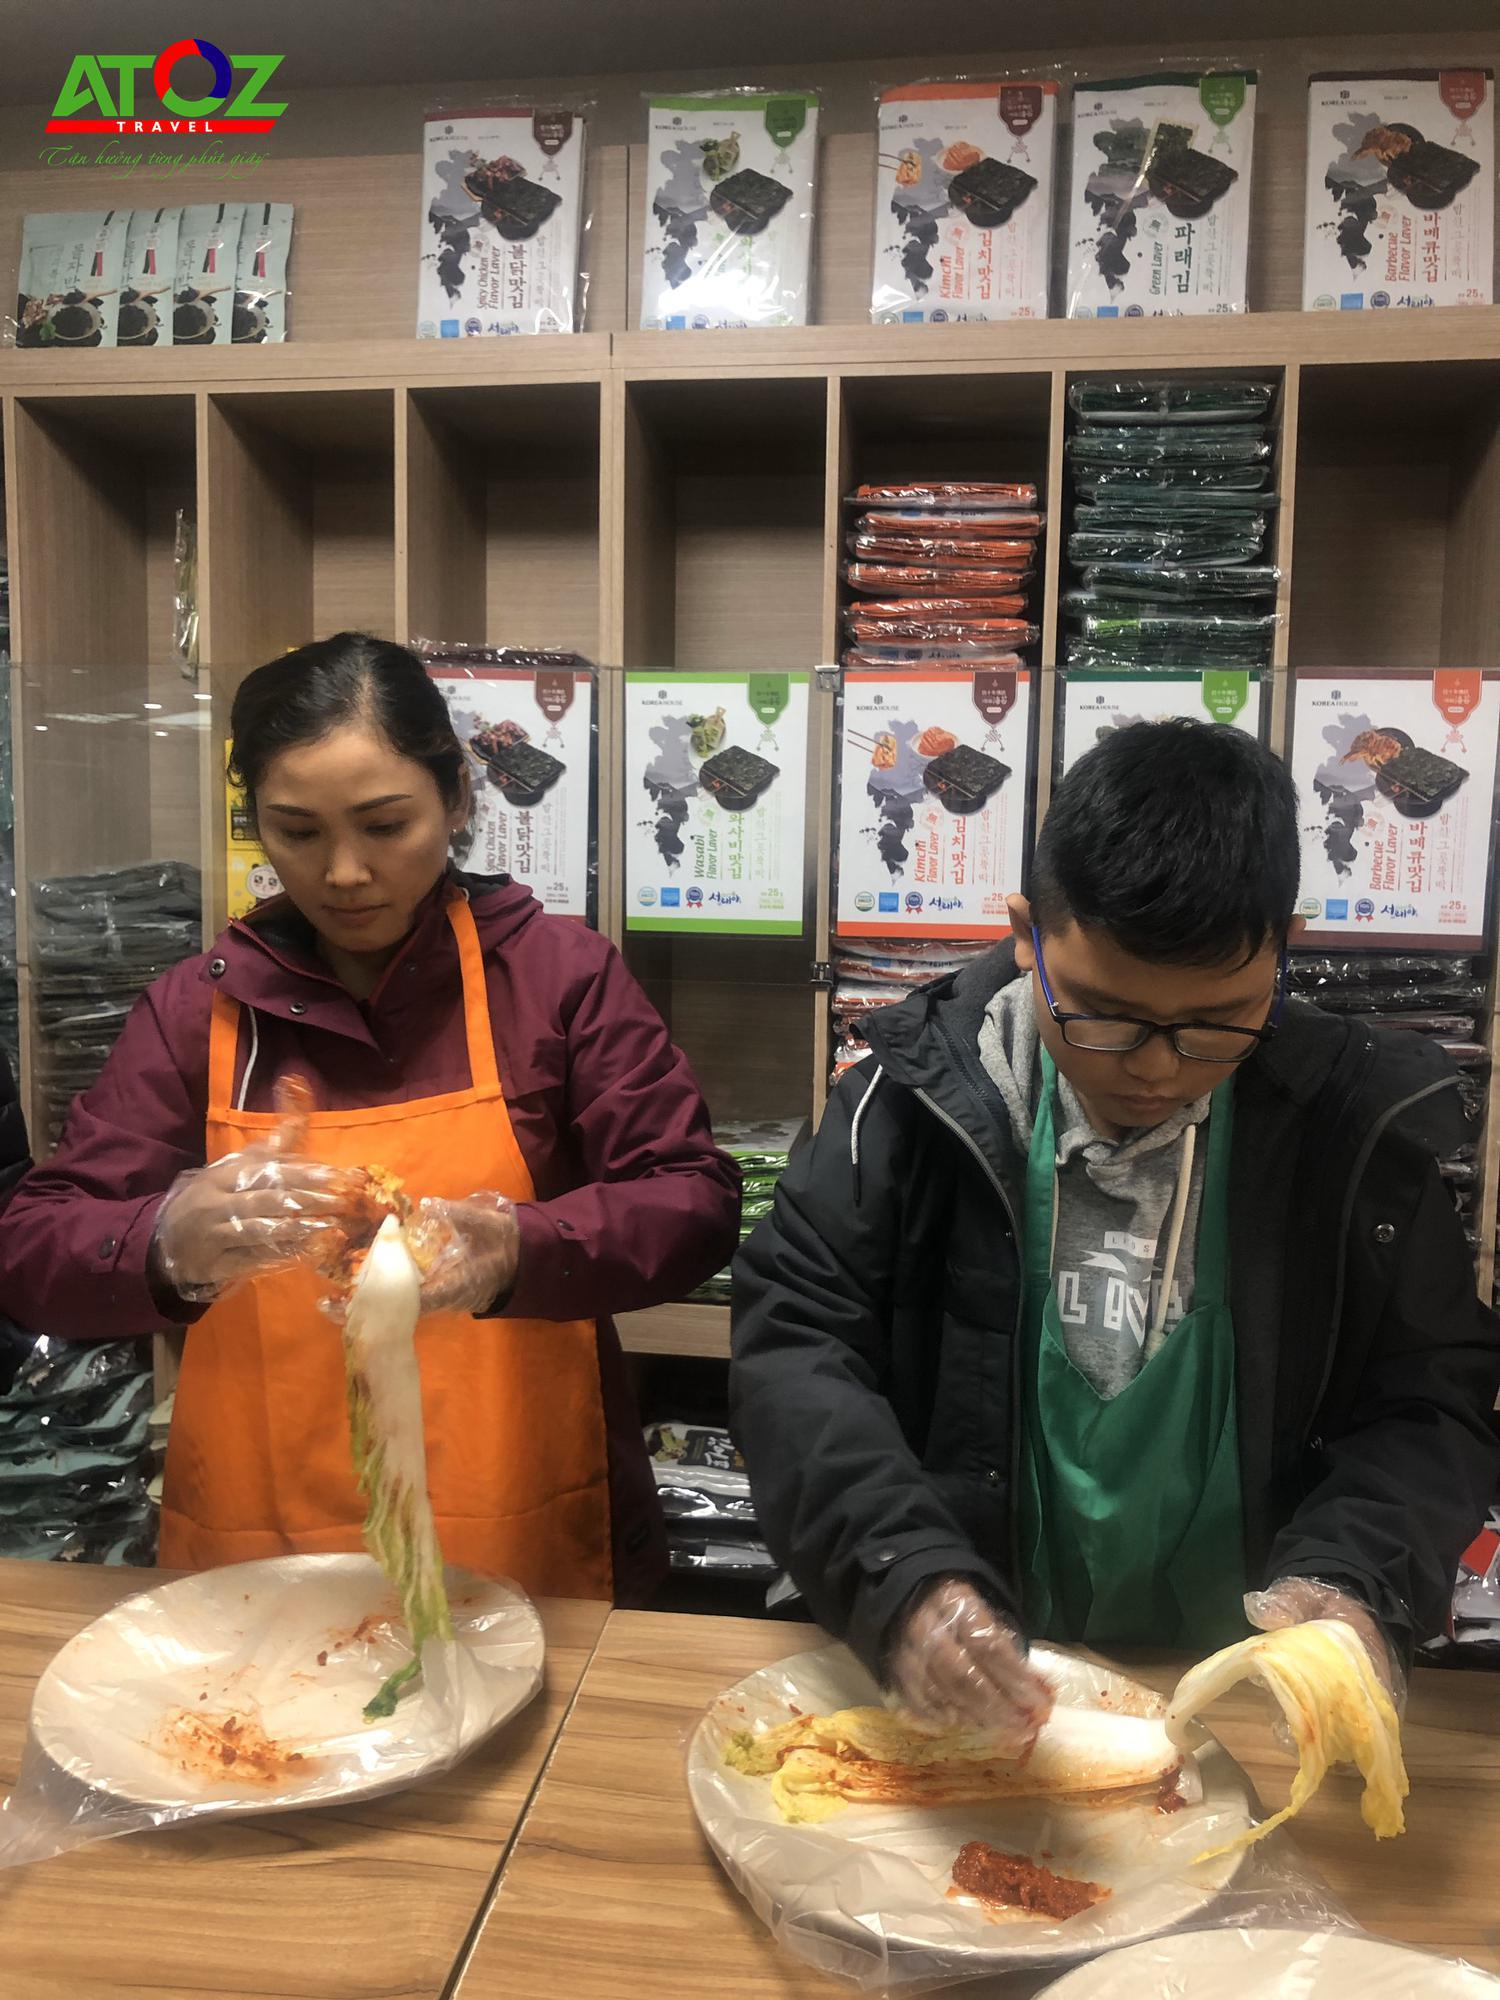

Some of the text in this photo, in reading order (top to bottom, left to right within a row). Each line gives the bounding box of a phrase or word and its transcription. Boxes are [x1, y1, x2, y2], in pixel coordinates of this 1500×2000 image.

[977, 229, 994, 300] 김치맛김
[1149, 241, 1163, 295] Green Laver
[1172, 222, 1196, 294] 파래김
[1385, 232, 1398, 282] Barbecue
[1399, 214, 1412, 281] Flavor Laver
[477, 289, 489, 310] Spicy
[488, 246, 501, 310] Flavor Laver
[940, 255, 952, 299] Kimchi
[1466, 288, 1479, 298] 25
[1019, 307, 1030, 317] 25
[1216, 304, 1228, 313] 25
[498, 810, 508, 840] Laver
[728, 812, 745, 880] 와사비맛김
[694, 834, 705, 879] Wasabi
[706, 829, 718, 880] Flavor Laver
[914, 840, 927, 883] Kimchi
[927, 831, 939, 883] Flavor Laver
[950, 815, 967, 885] 김치맛김
[1369, 840, 1384, 891] Barbecue
[1383, 822, 1398, 892] Flavor Laver
[553, 882, 564, 892] 25
[768, 888, 779, 897] 25
[991, 892, 1004, 902] 25
[1449, 900, 1461, 910] 25
